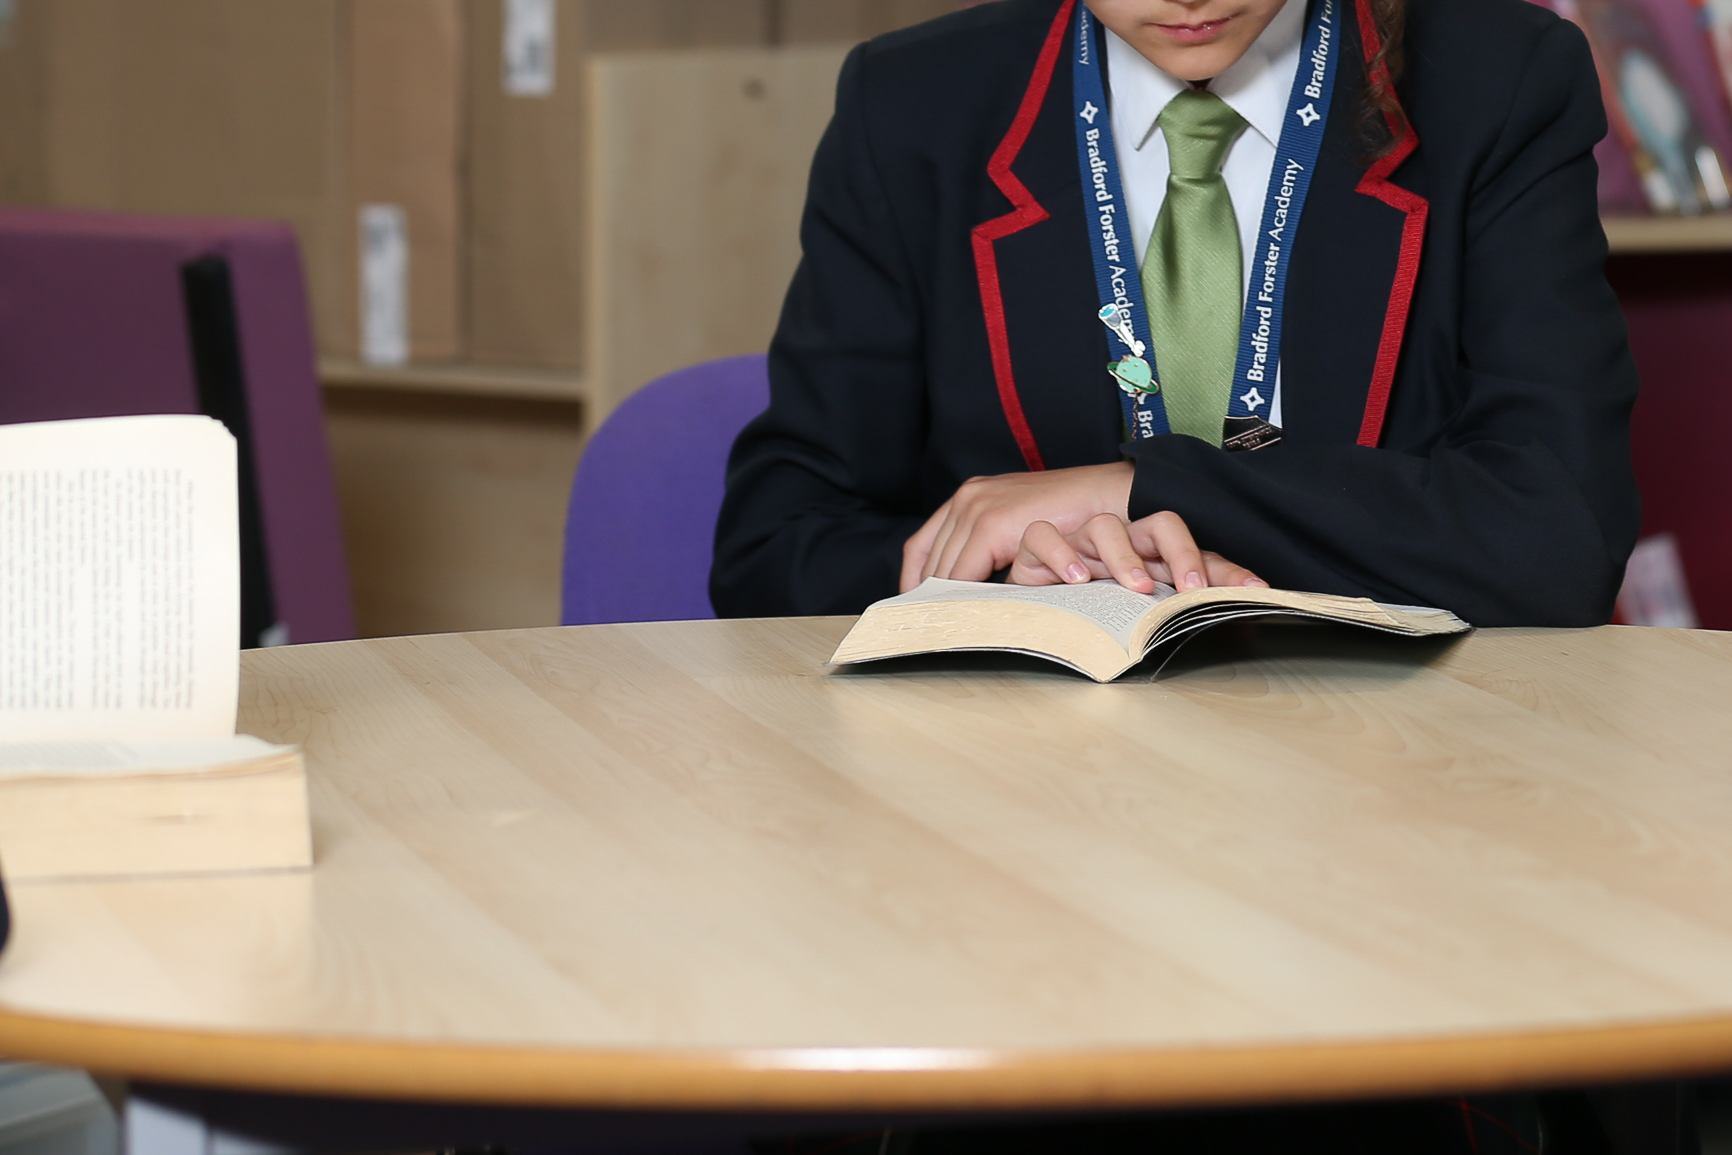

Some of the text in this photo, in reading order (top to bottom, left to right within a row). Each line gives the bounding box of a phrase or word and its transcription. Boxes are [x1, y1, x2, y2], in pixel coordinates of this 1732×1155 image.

[1304, 25, 1331, 98] Bradford
[1086, 128, 1134, 335] Bradford Forster Academ
[1246, 158, 1305, 382] Bradford Forster Academy
